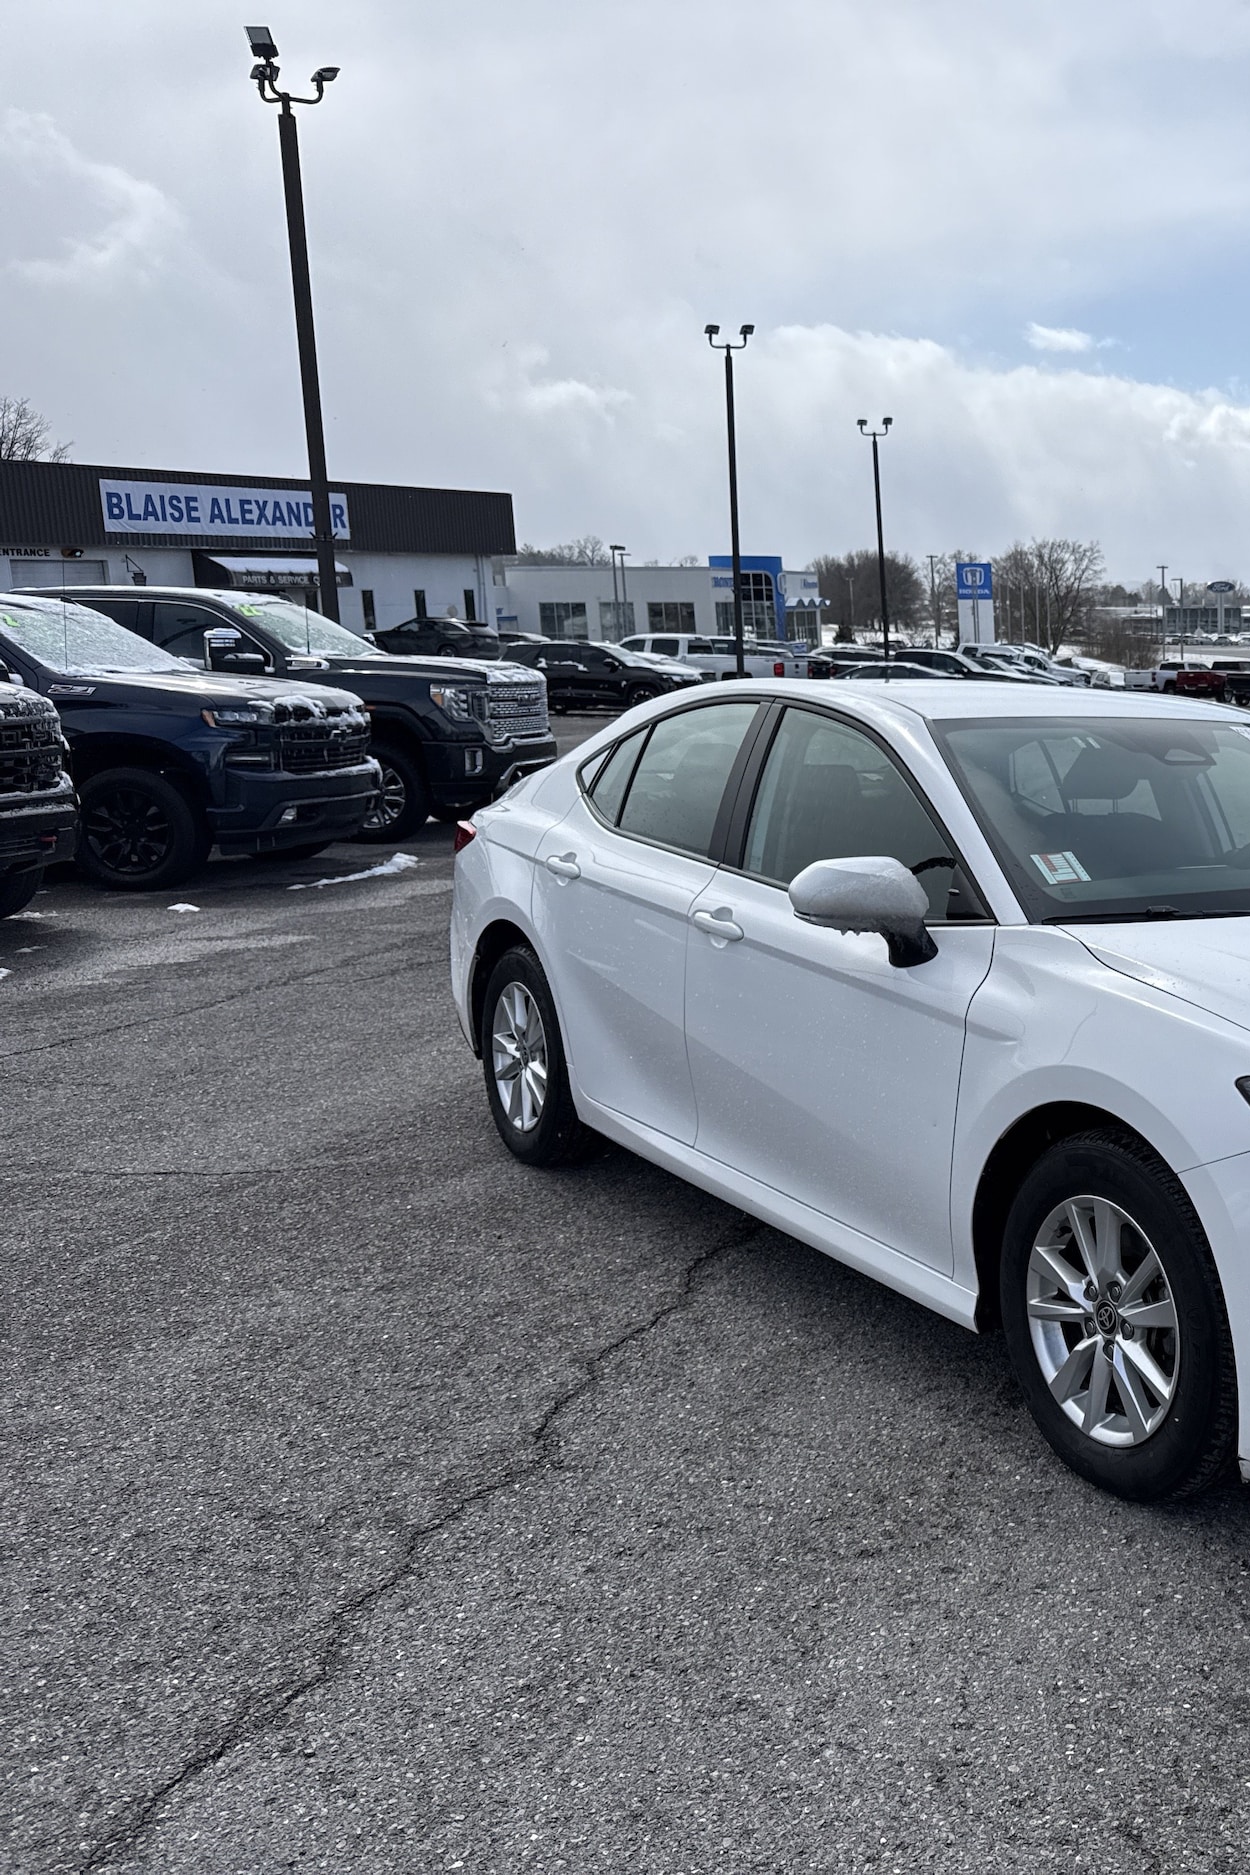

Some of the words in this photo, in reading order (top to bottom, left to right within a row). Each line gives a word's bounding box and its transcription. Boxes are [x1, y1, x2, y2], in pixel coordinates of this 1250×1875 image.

[106, 491, 201, 524] BLAISE
[209, 497, 347, 529] ALEXANDR
[242, 575, 268, 585] PARTS
[269, 575, 276, 584] &
[278, 575, 310, 585] SERVICE
